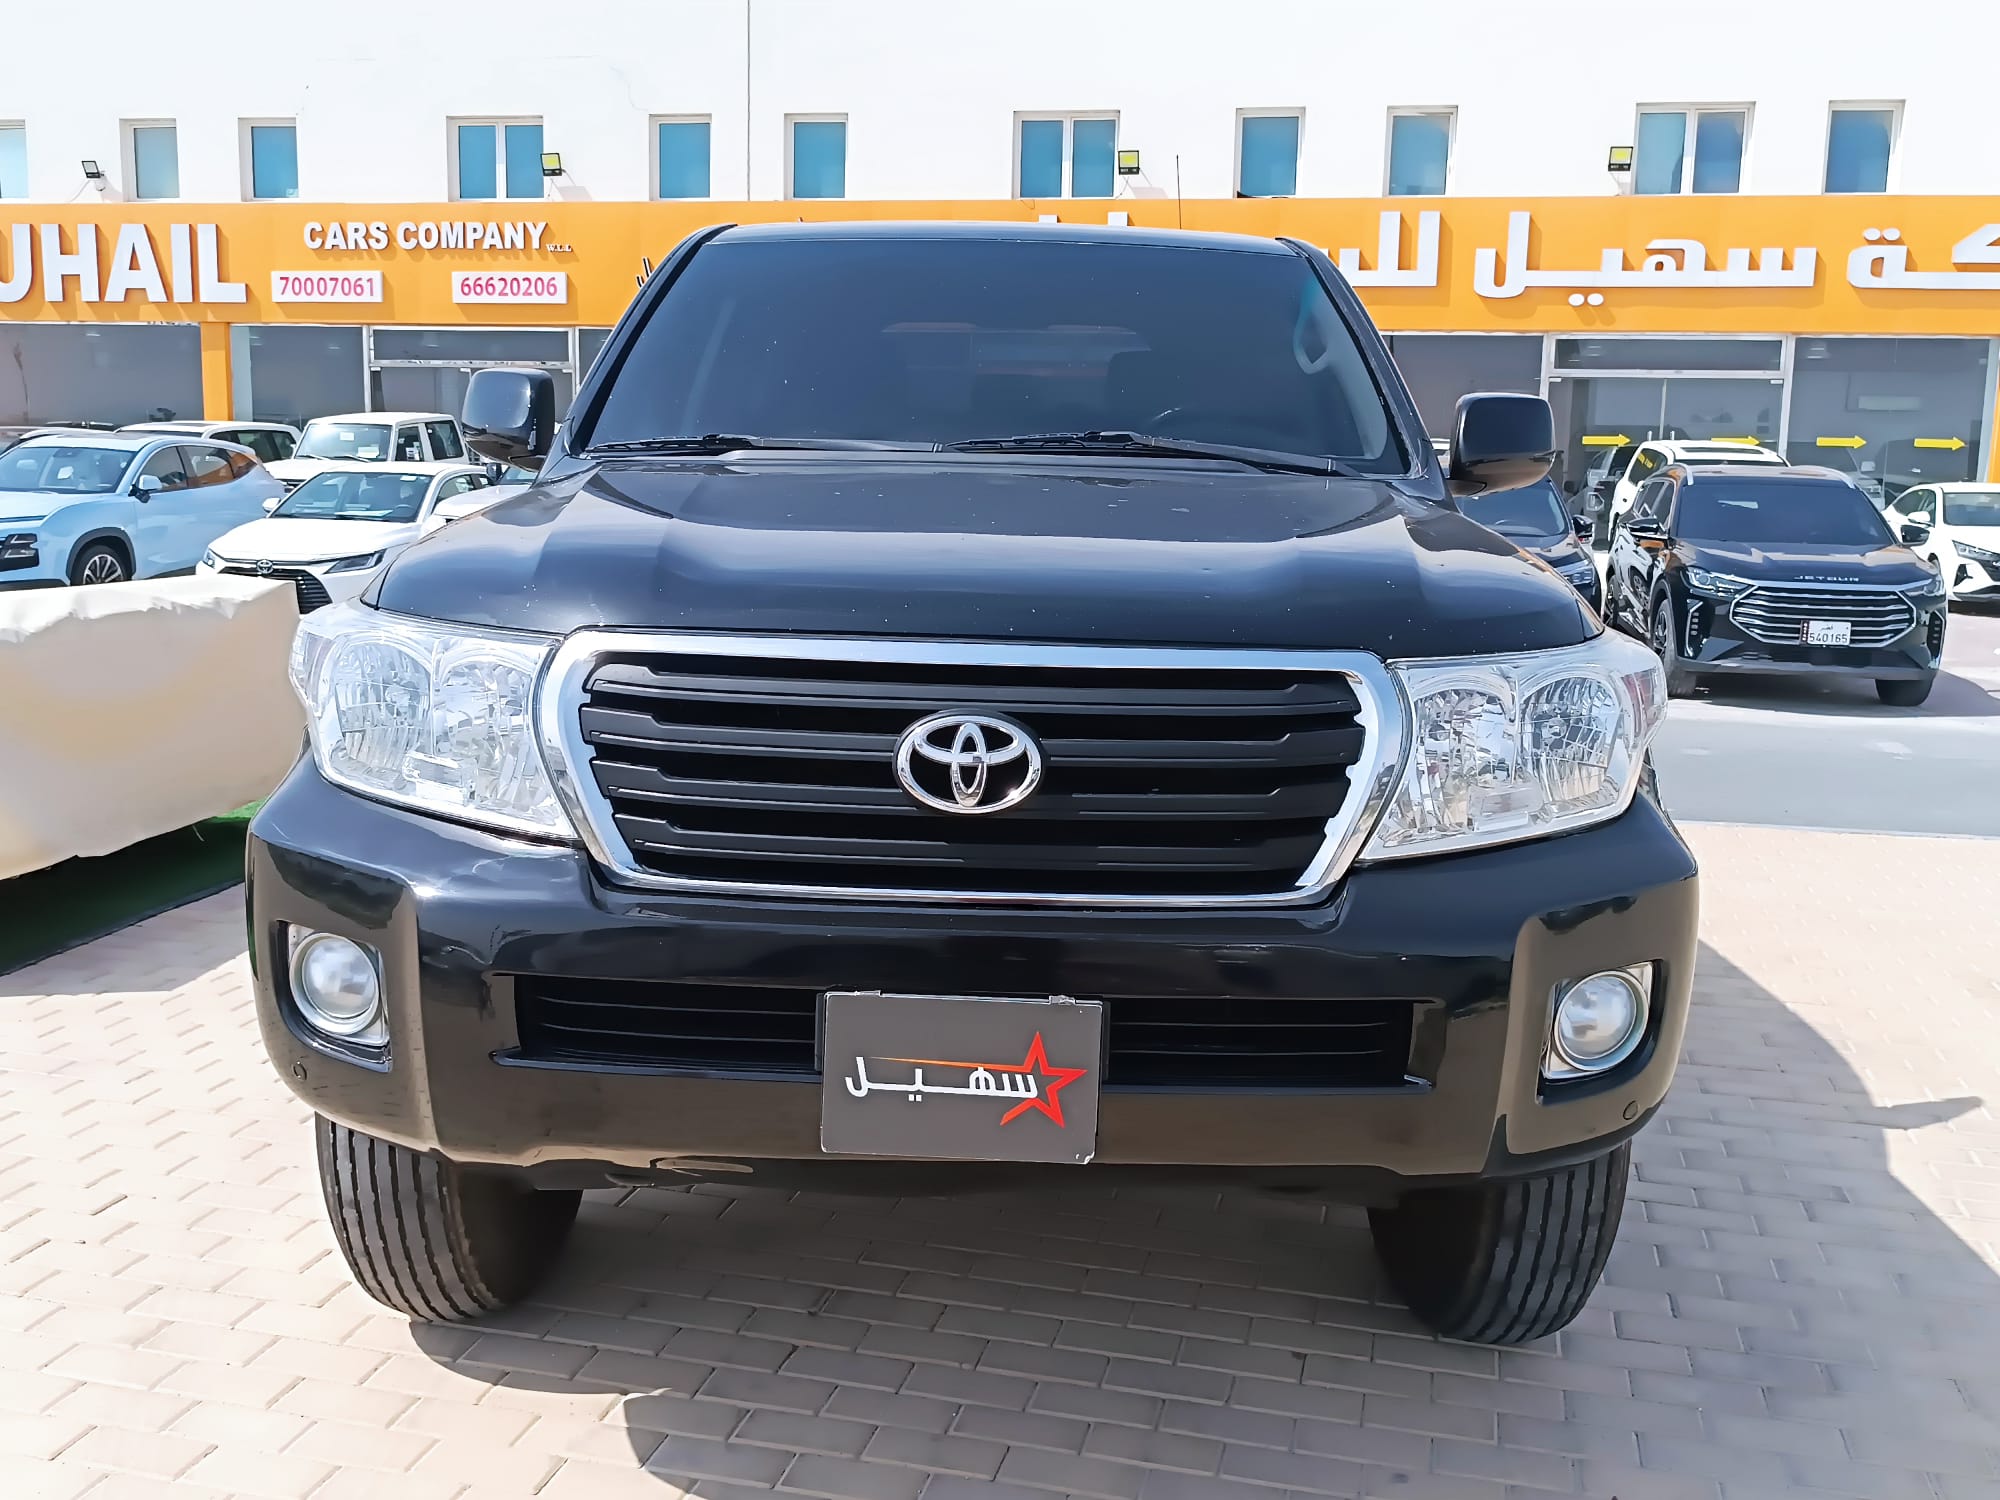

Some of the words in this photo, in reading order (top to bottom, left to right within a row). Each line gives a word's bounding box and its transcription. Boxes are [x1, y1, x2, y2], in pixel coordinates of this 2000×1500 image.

[303, 221, 389, 250] CARS
[396, 221, 547, 249] COMPANY
[1473, 211, 1817, 307] سهيل
[279, 276, 375, 297] 70007061
[460, 276, 558, 297] 66620206
[1809, 632, 1848, 643] 540165
[844, 1056, 1038, 1102] سهيل
